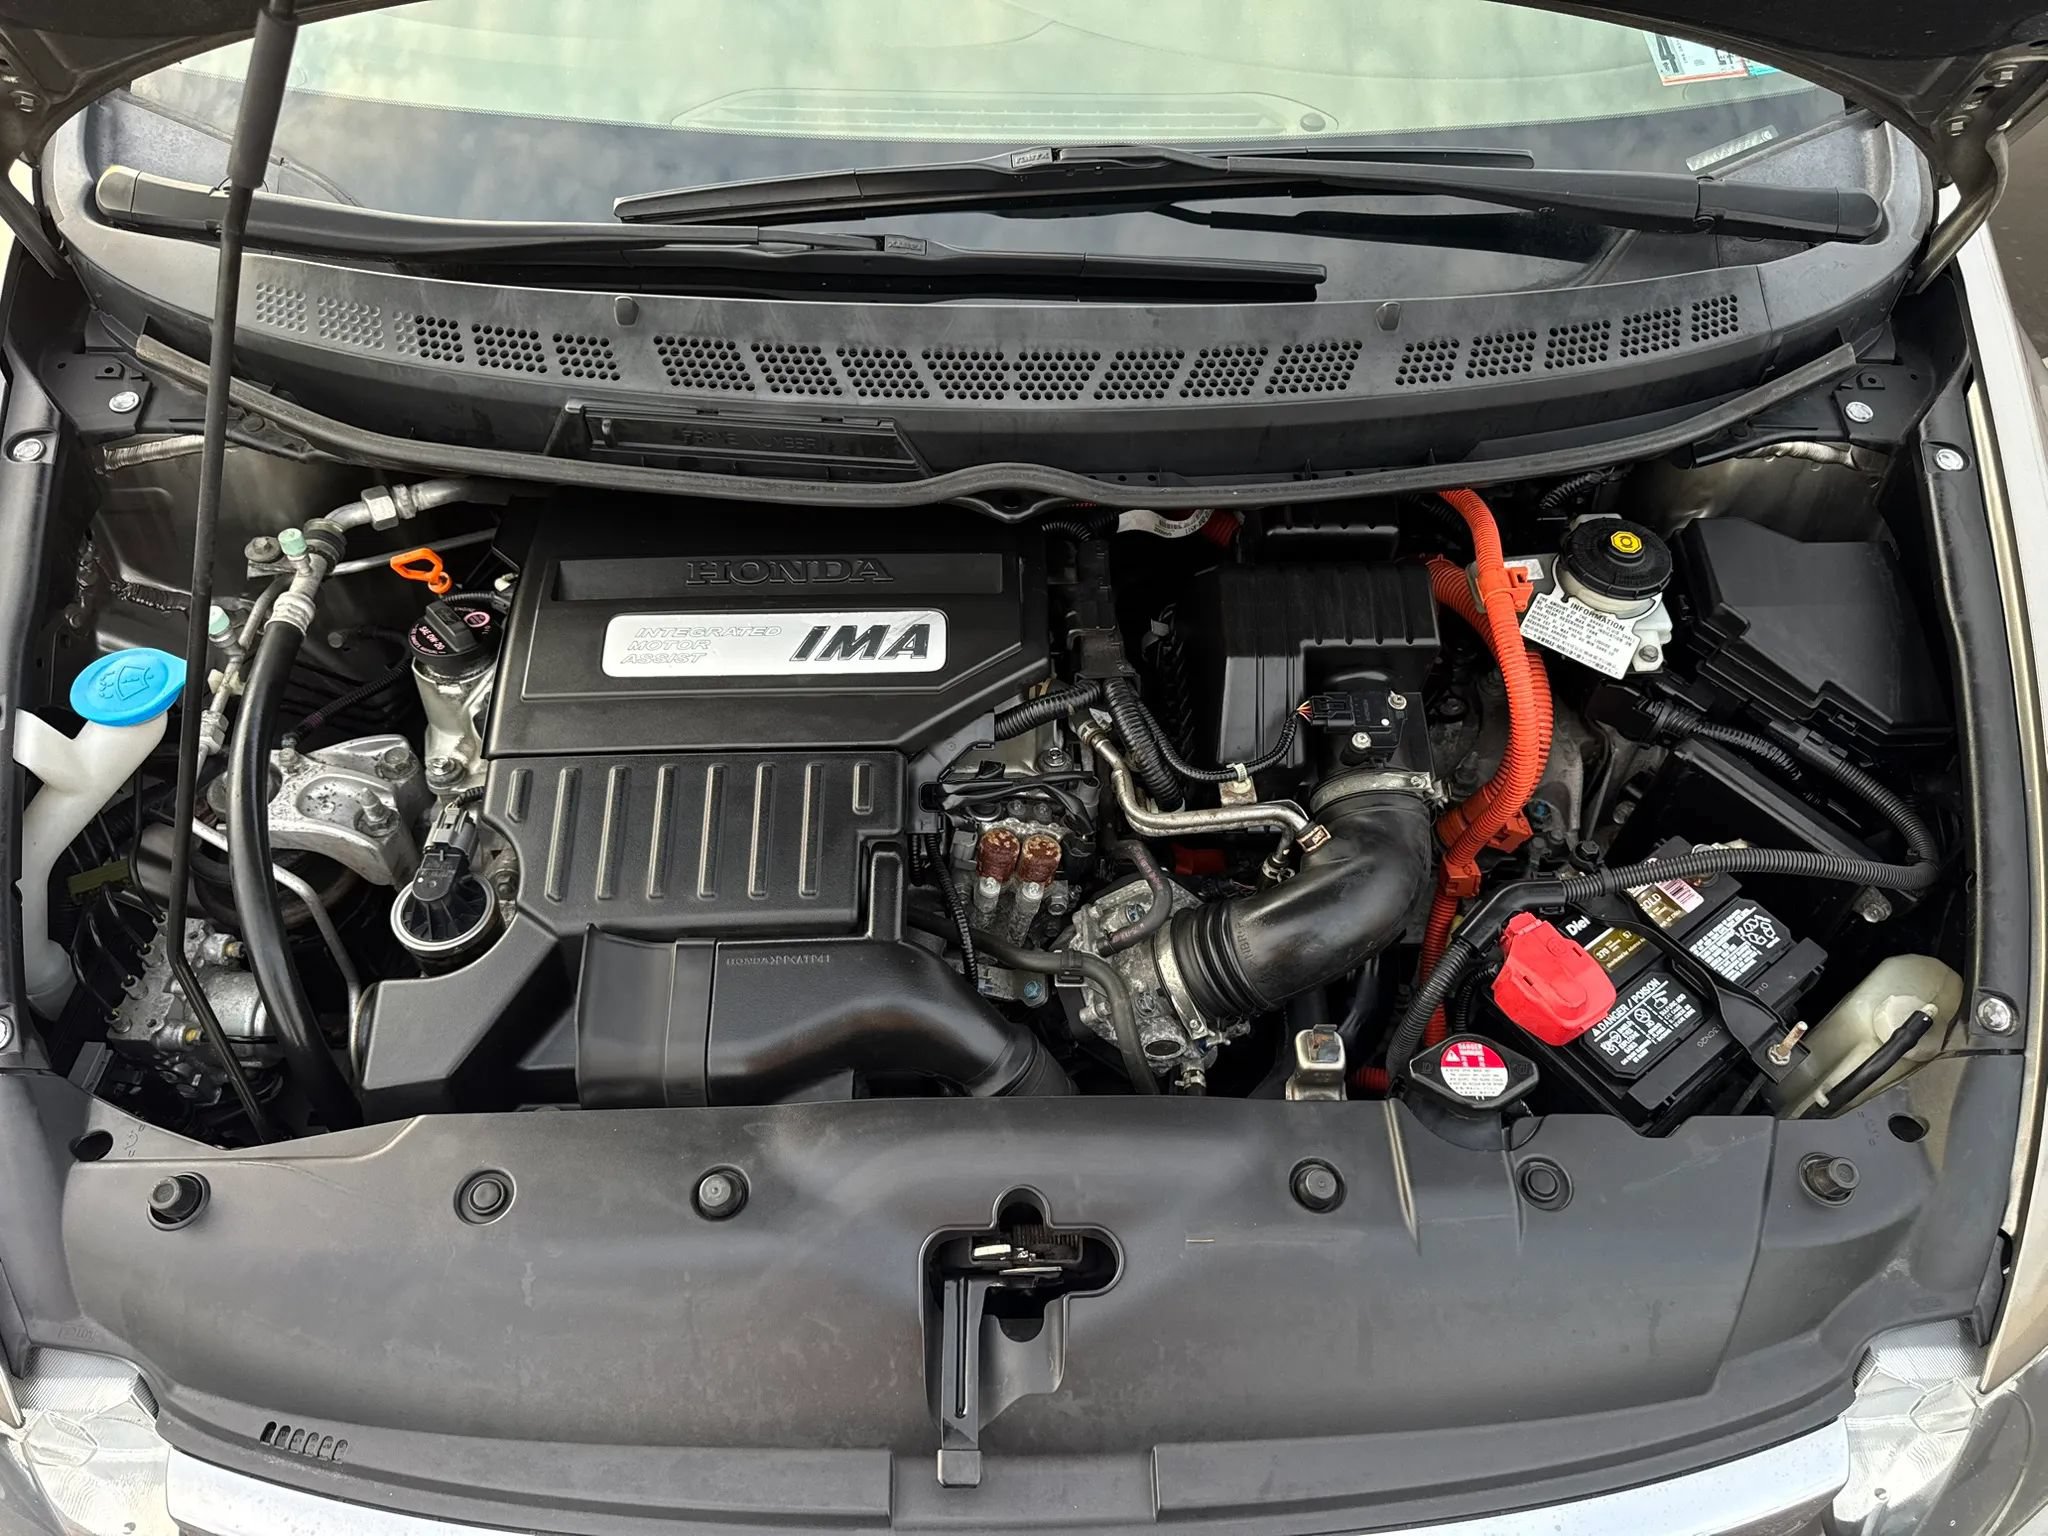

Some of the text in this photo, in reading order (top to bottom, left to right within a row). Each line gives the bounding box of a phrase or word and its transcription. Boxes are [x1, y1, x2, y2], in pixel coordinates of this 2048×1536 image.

[684, 429, 739, 446] FRAME
[686, 557, 894, 585] HONDA
[1570, 602, 1626, 632] INFORMATION
[635, 626, 782, 638] INTEGRATED
[788, 623, 930, 661] IMA
[628, 639, 711, 651] MOTOR
[620, 652, 707, 664] ASSIST
[1599, 1003, 1630, 1031] DANGER
[1631, 978, 1661, 1003] POISON
